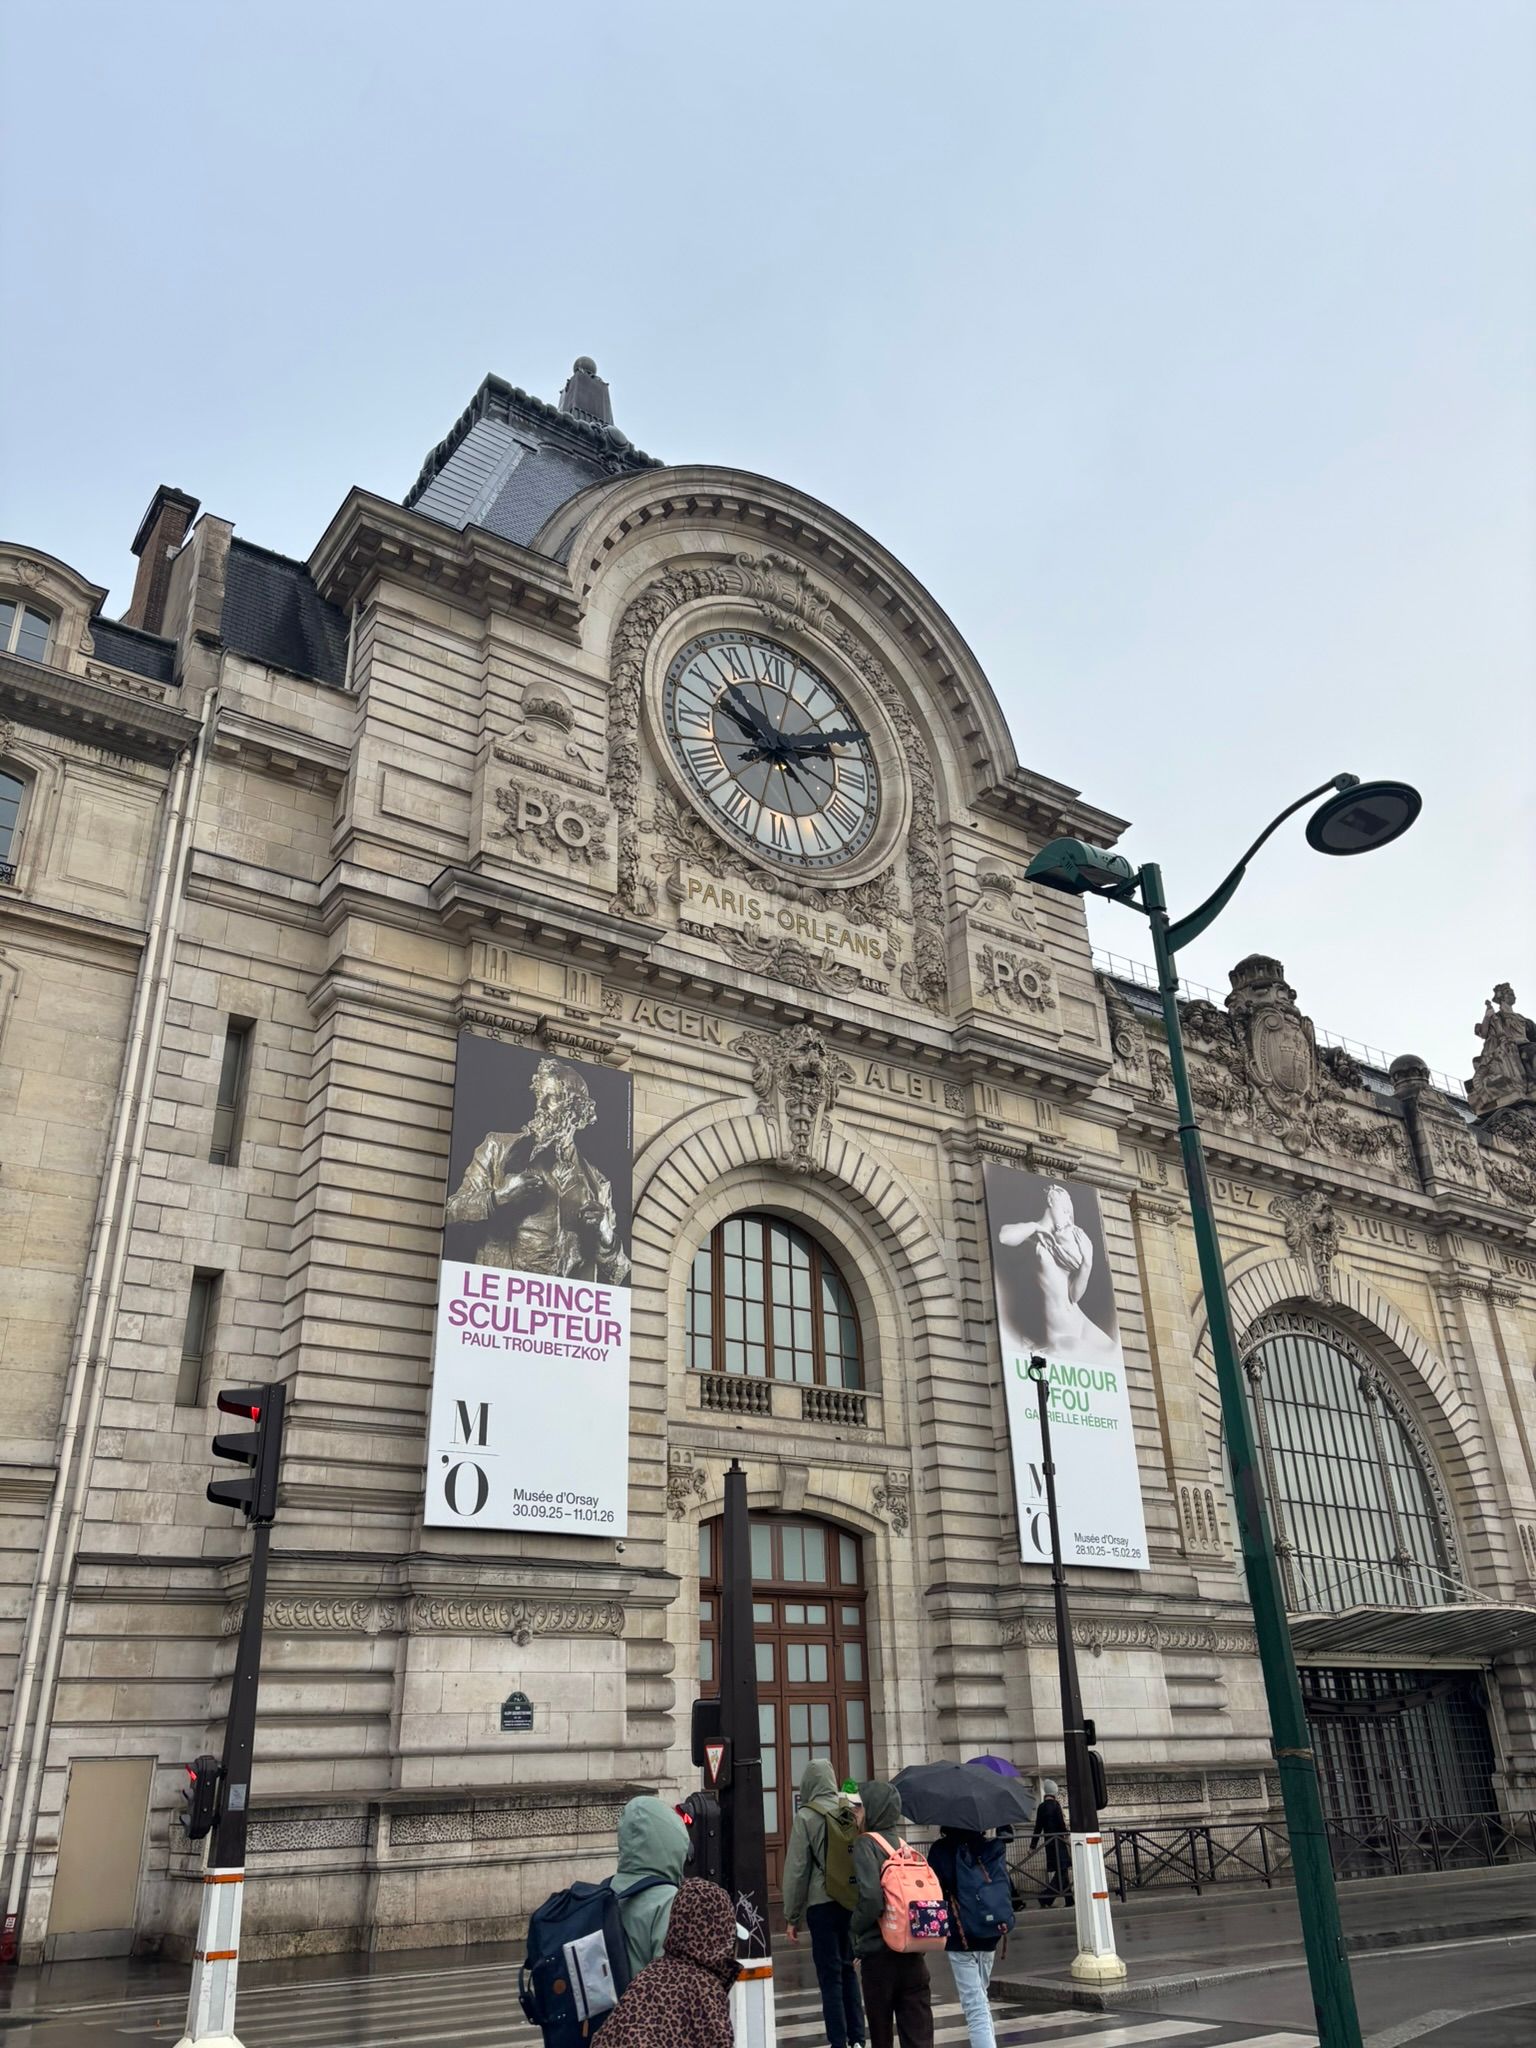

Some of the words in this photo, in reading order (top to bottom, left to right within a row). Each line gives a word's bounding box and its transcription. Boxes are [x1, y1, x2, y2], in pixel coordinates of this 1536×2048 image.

[759, 651, 787, 690] XII
[517, 796, 592, 847] PO
[993, 958, 1042, 998] PO
[864, 1062, 937, 1103] ALBI
[1352, 1215, 1418, 1250] TULLE
[463, 1271, 500, 1300] LE
[506, 1277, 612, 1316] PRINCE
[448, 1299, 622, 1347] SCULPTEUR
[462, 1331, 501, 1349] PAUL
[502, 1336, 609, 1362] TROUBETZKOY
[1049, 1363, 1118, 1393] AMOUR
[1050, 1387, 1090, 1412] FOU
[449, 1399, 493, 1446] M
[1024, 1407, 1079, 1425] GARIELLE
[1080, 1412, 1119, 1430] HÉBERT
[513, 1488, 553, 1503] Musée
[556, 1492, 599, 1508] d'Orsay
[1074, 1532, 1101, 1544] Musée
[1101, 1534, 1129, 1546] d'Orsay
